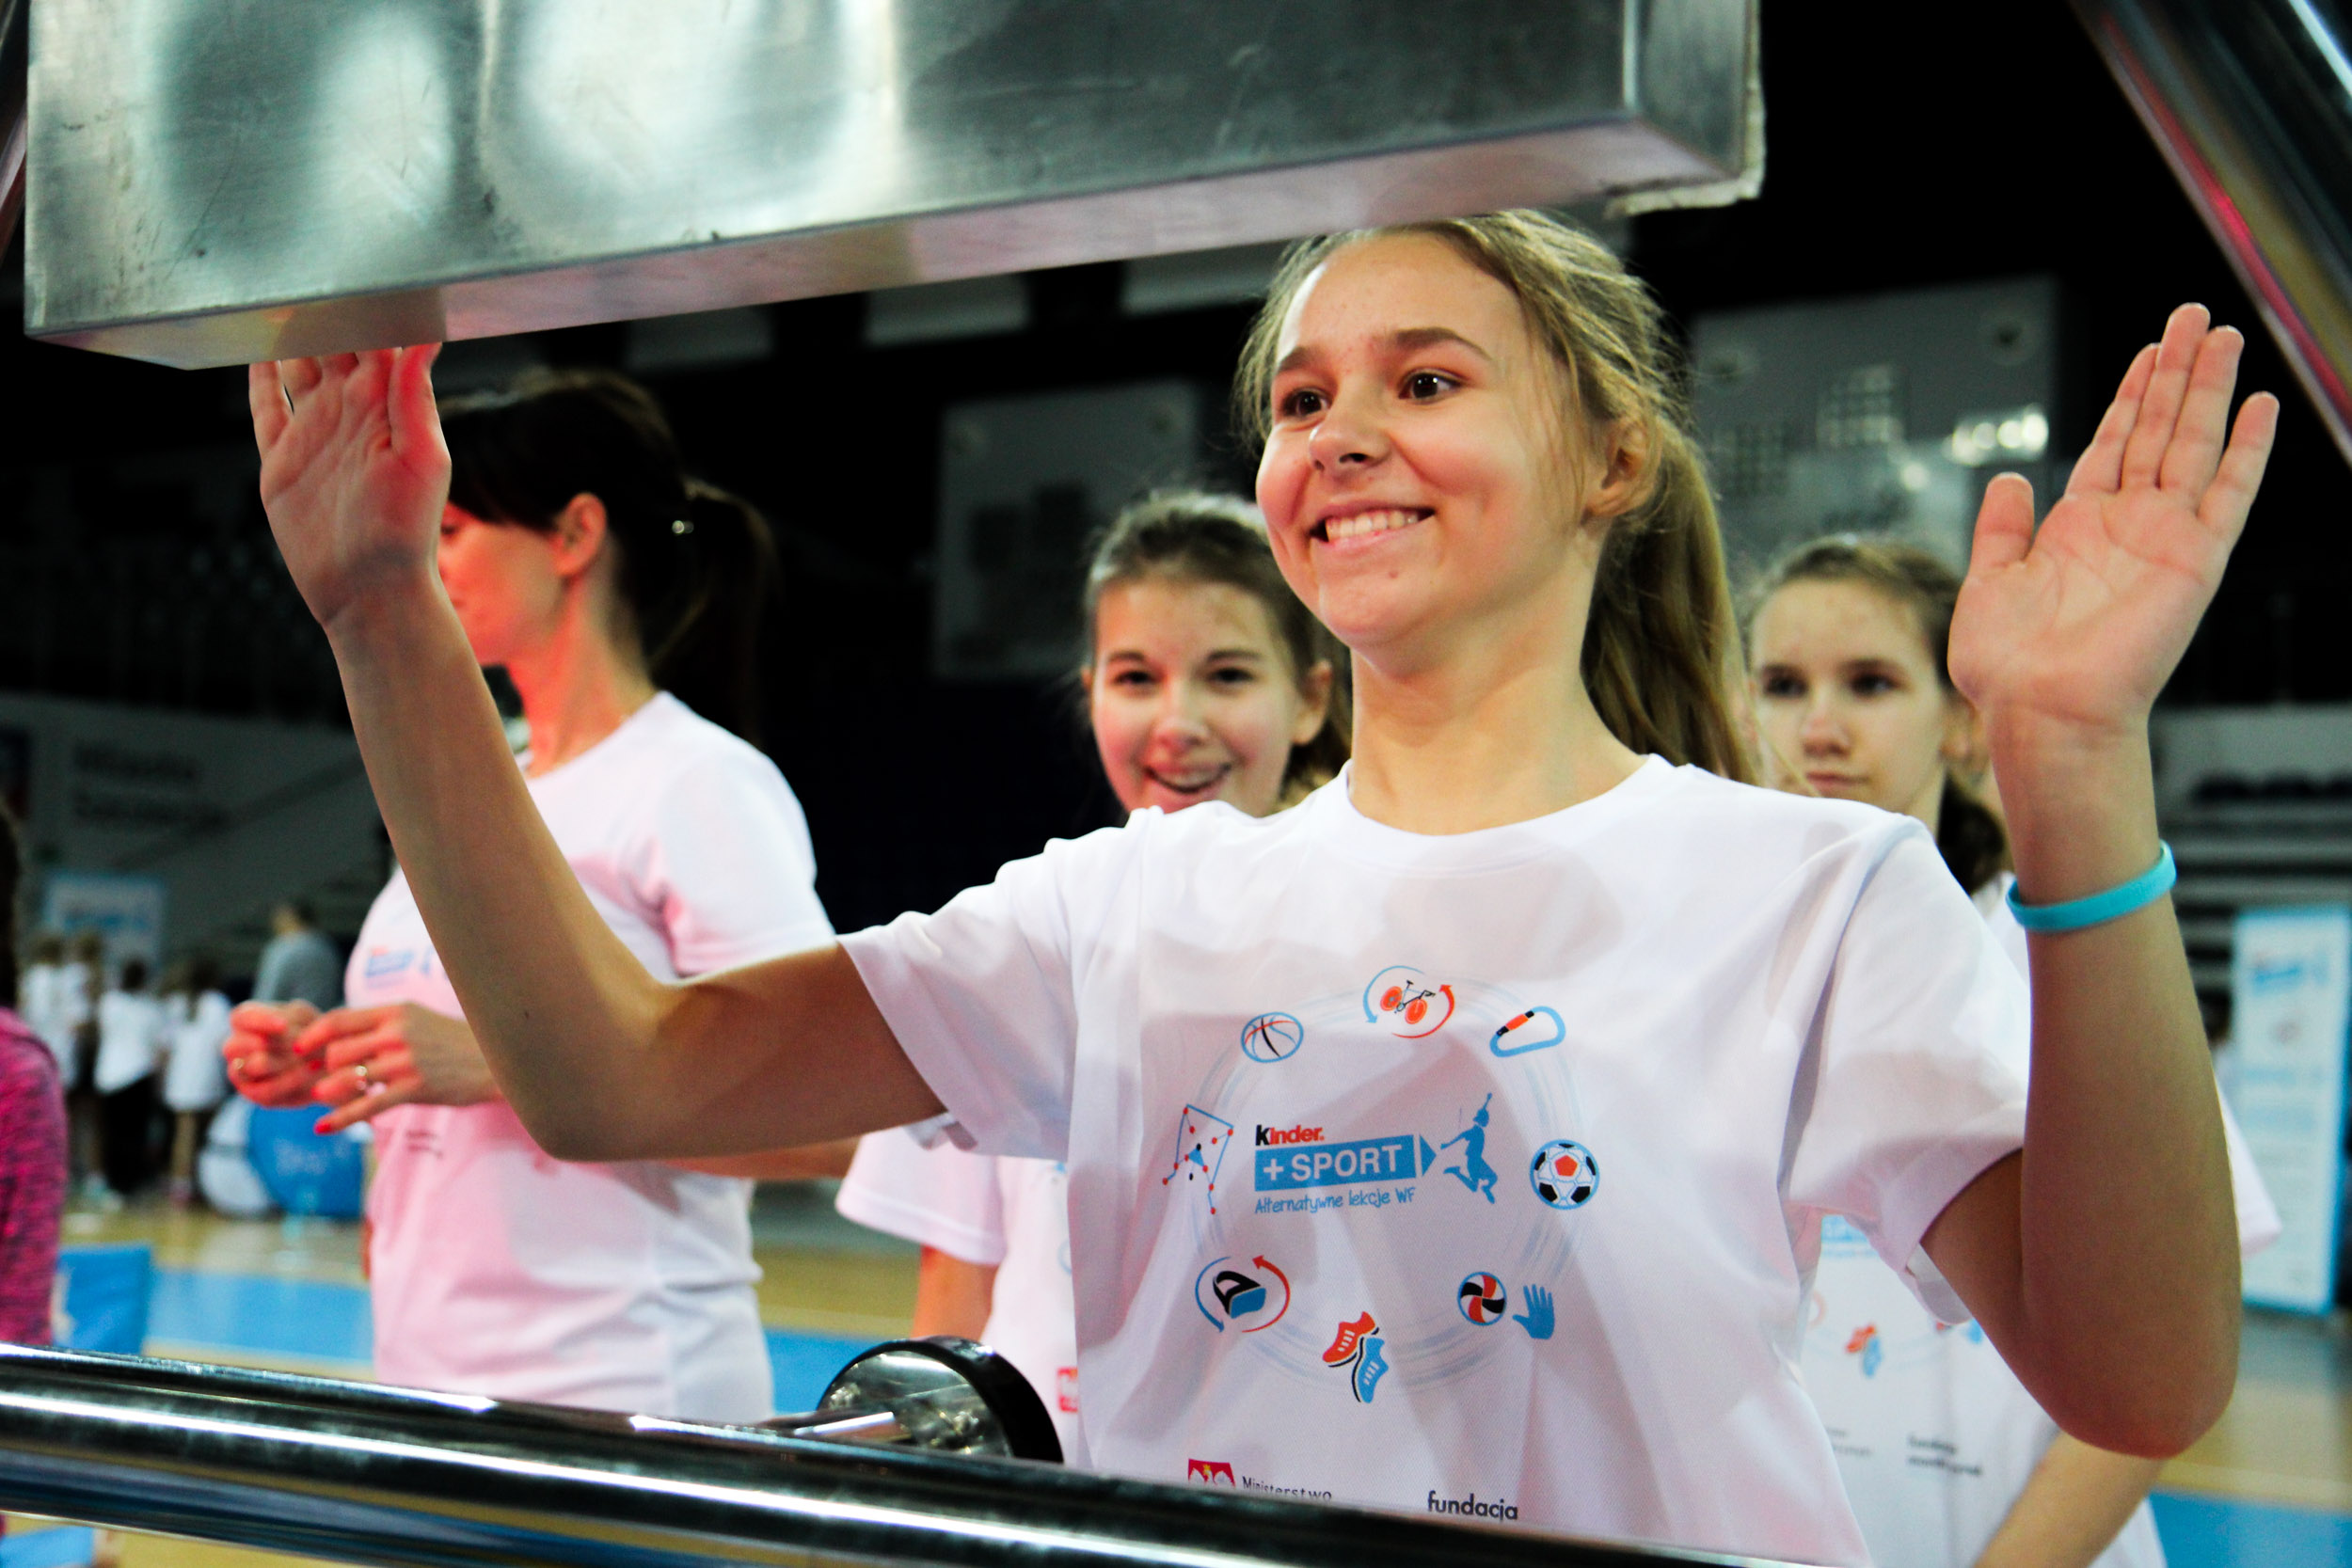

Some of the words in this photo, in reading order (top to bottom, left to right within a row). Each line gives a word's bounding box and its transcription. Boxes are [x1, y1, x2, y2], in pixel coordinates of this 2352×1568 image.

[1291, 1144, 1403, 1182] SPORT
[1254, 1194, 1343, 1214] Alternatywne
[1348, 1189, 1391, 1208] lekcje
[1395, 1186, 1416, 1203] WF
[1427, 1489, 1518, 1521] fundacja
